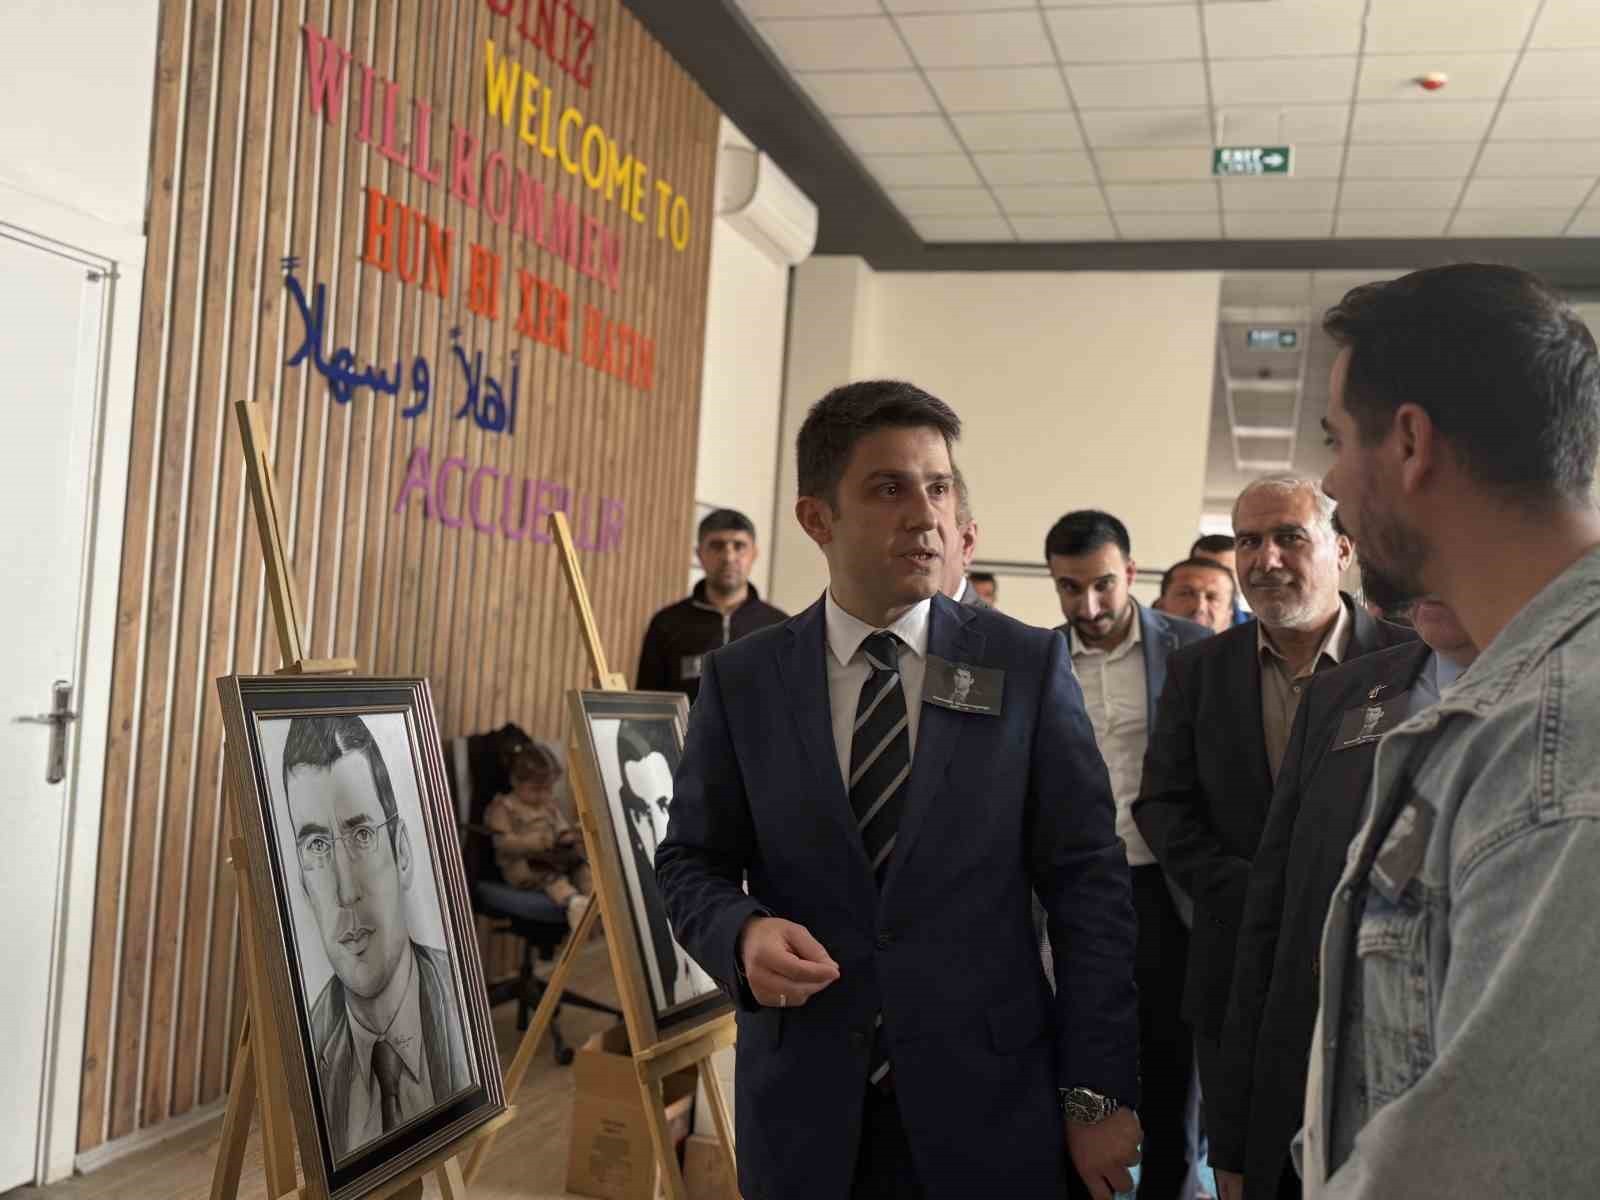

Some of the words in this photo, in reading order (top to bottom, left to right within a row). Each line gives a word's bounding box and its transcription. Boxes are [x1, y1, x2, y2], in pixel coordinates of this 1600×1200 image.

[302, 23, 621, 291] WILLKOMMEN
[485, 38, 647, 224] WELCOME
[655, 179, 690, 251] TO
[362, 187, 455, 299] HUN
[467, 243, 502, 321] BI
